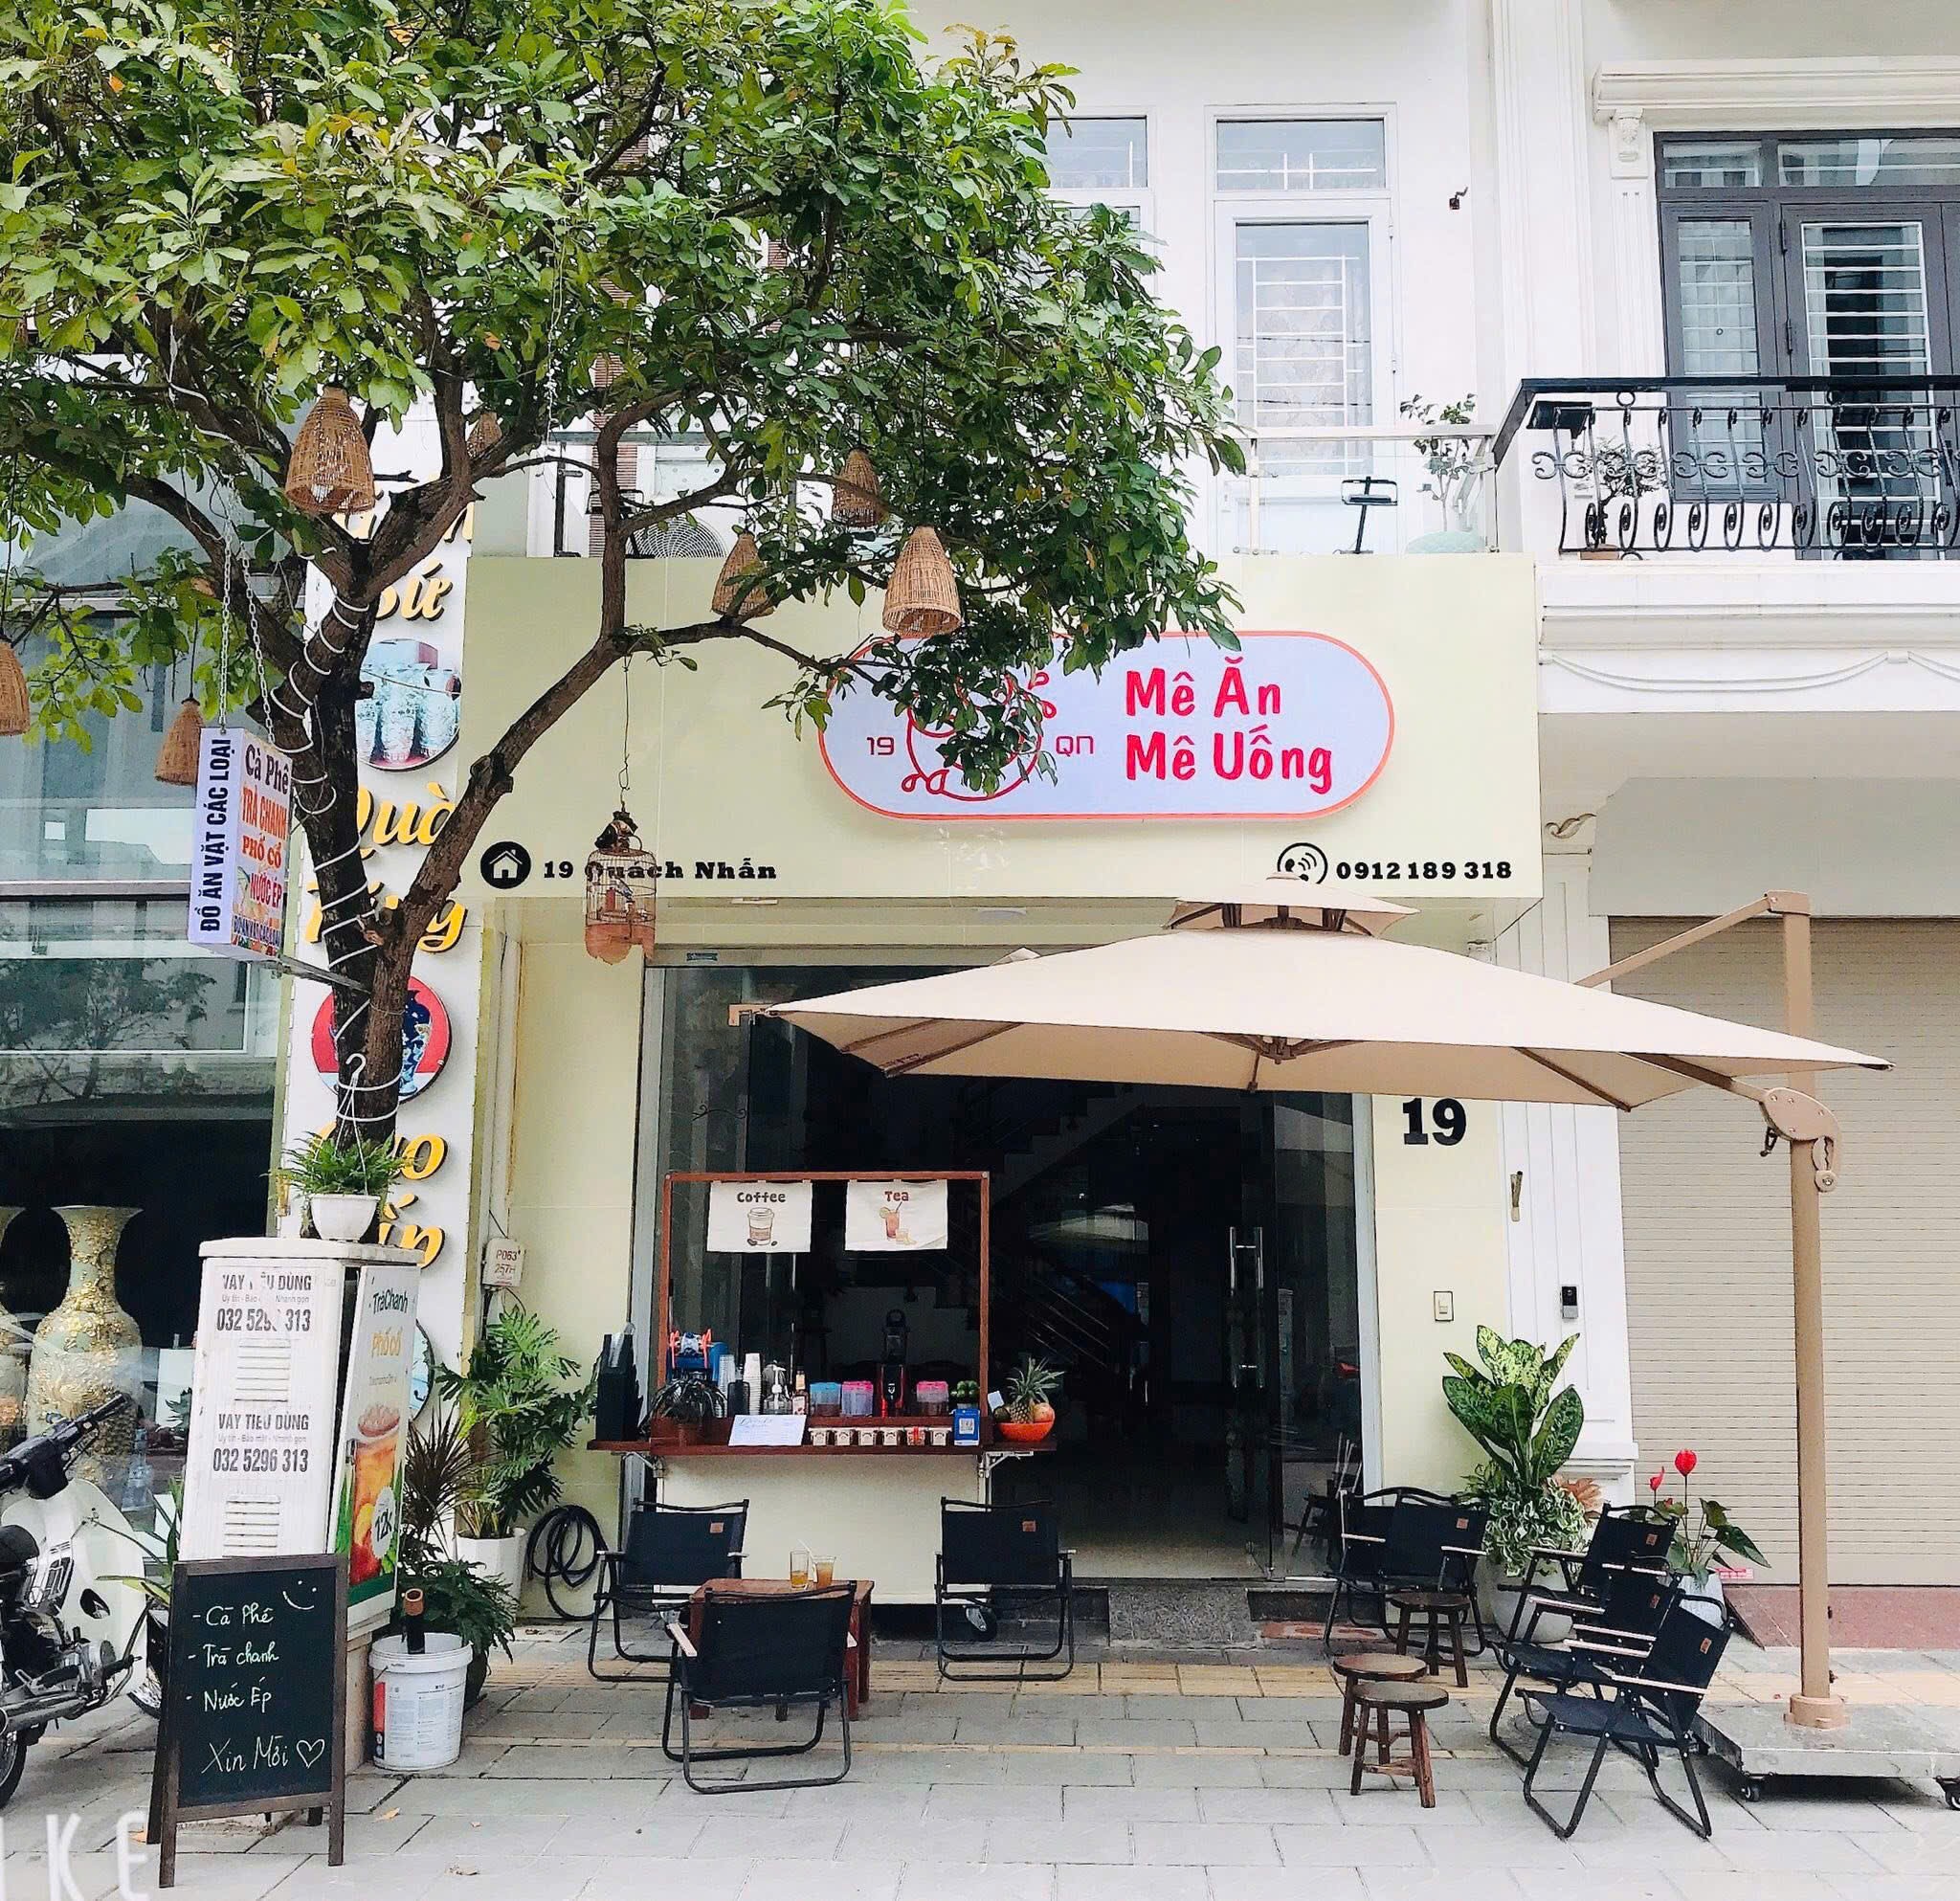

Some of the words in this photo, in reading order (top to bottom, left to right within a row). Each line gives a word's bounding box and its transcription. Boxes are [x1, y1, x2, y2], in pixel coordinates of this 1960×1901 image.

[1125, 667, 1196, 717] Mê
[1214, 656, 1281, 718] Ăn
[866, 736, 896, 756] 19
[1125, 731, 1196, 781] Mê
[1214, 724, 1332, 794] Uống
[209, 738, 235, 781] LOẠI
[245, 744, 262, 781] Cà
[265, 754, 289, 794] Phê
[203, 787, 229, 825] CÁC
[544, 861, 574, 880] 19
[695, 858, 777, 880] Nhẫn
[1336, 861, 1401, 880] 0912
[1408, 861, 1457, 880] 189
[1463, 861, 1512, 880] 318
[197, 872, 223, 900] ĂN
[1402, 1097, 1467, 1146] 19
[736, 1192, 787, 1203] Coffee
[884, 1190, 910, 1202] Tea
[222, 1274, 245, 1290] VAY
[216, 1308, 243, 1331] 032
[284, 1308, 312, 1332] 313
[218, 1413, 241, 1430] VAY
[212, 1447, 239, 1472] 032
[243, 1447, 278, 1472] 5296
[281, 1448, 309, 1472] 313
[201, 1737, 247, 1774] Xin
